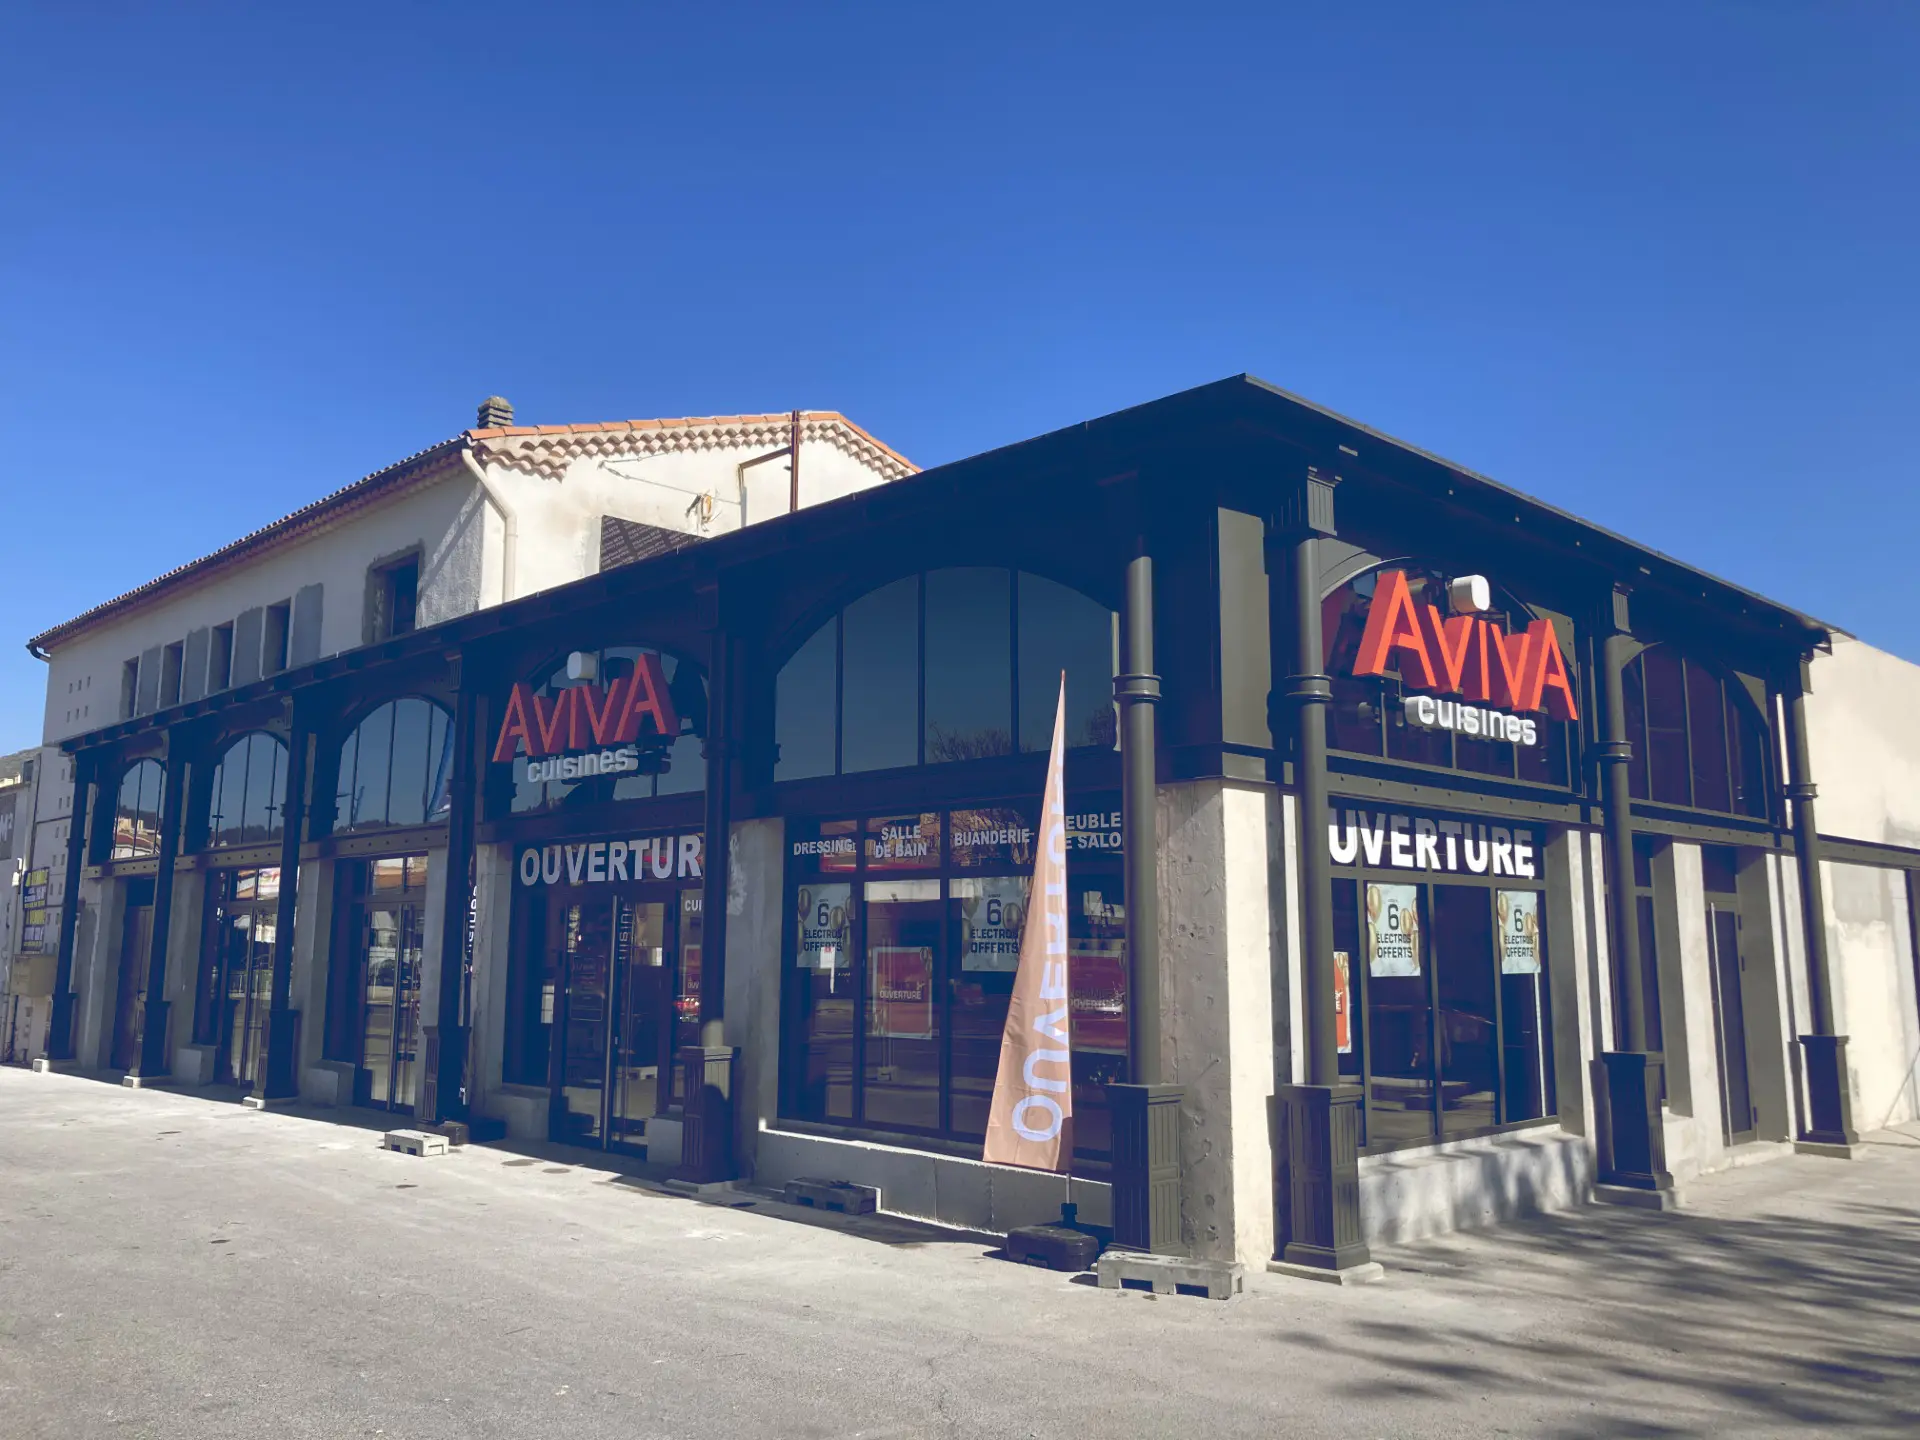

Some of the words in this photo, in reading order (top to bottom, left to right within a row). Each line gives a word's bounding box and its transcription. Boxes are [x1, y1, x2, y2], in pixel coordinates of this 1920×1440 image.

[1352, 570, 1578, 720] AVIVA
[492, 652, 681, 763] AVIVA
[1406, 695, 1537, 746] cuisines
[527, 748, 638, 783] cuisines
[881, 825, 921, 841] SALLE
[1066, 812, 1121, 830] EUBLE
[793, 838, 852, 856] DRESSING
[954, 828, 1030, 847] BUANDERIE
[1077, 832, 1122, 850] SALO
[1328, 807, 1534, 878] UVERTURE
[520, 835, 702, 886] OUVERTUR
[875, 844, 891, 858] DE
[895, 842, 927, 858] BAIN
[817, 903, 829, 927] 6
[986, 898, 1001, 926] 6
[1387, 904, 1399, 930] 6
[1514, 908, 1524, 933] 6
[970, 942, 1018, 954] OFFERTS
[1377, 947, 1412, 958] OFFERTS
